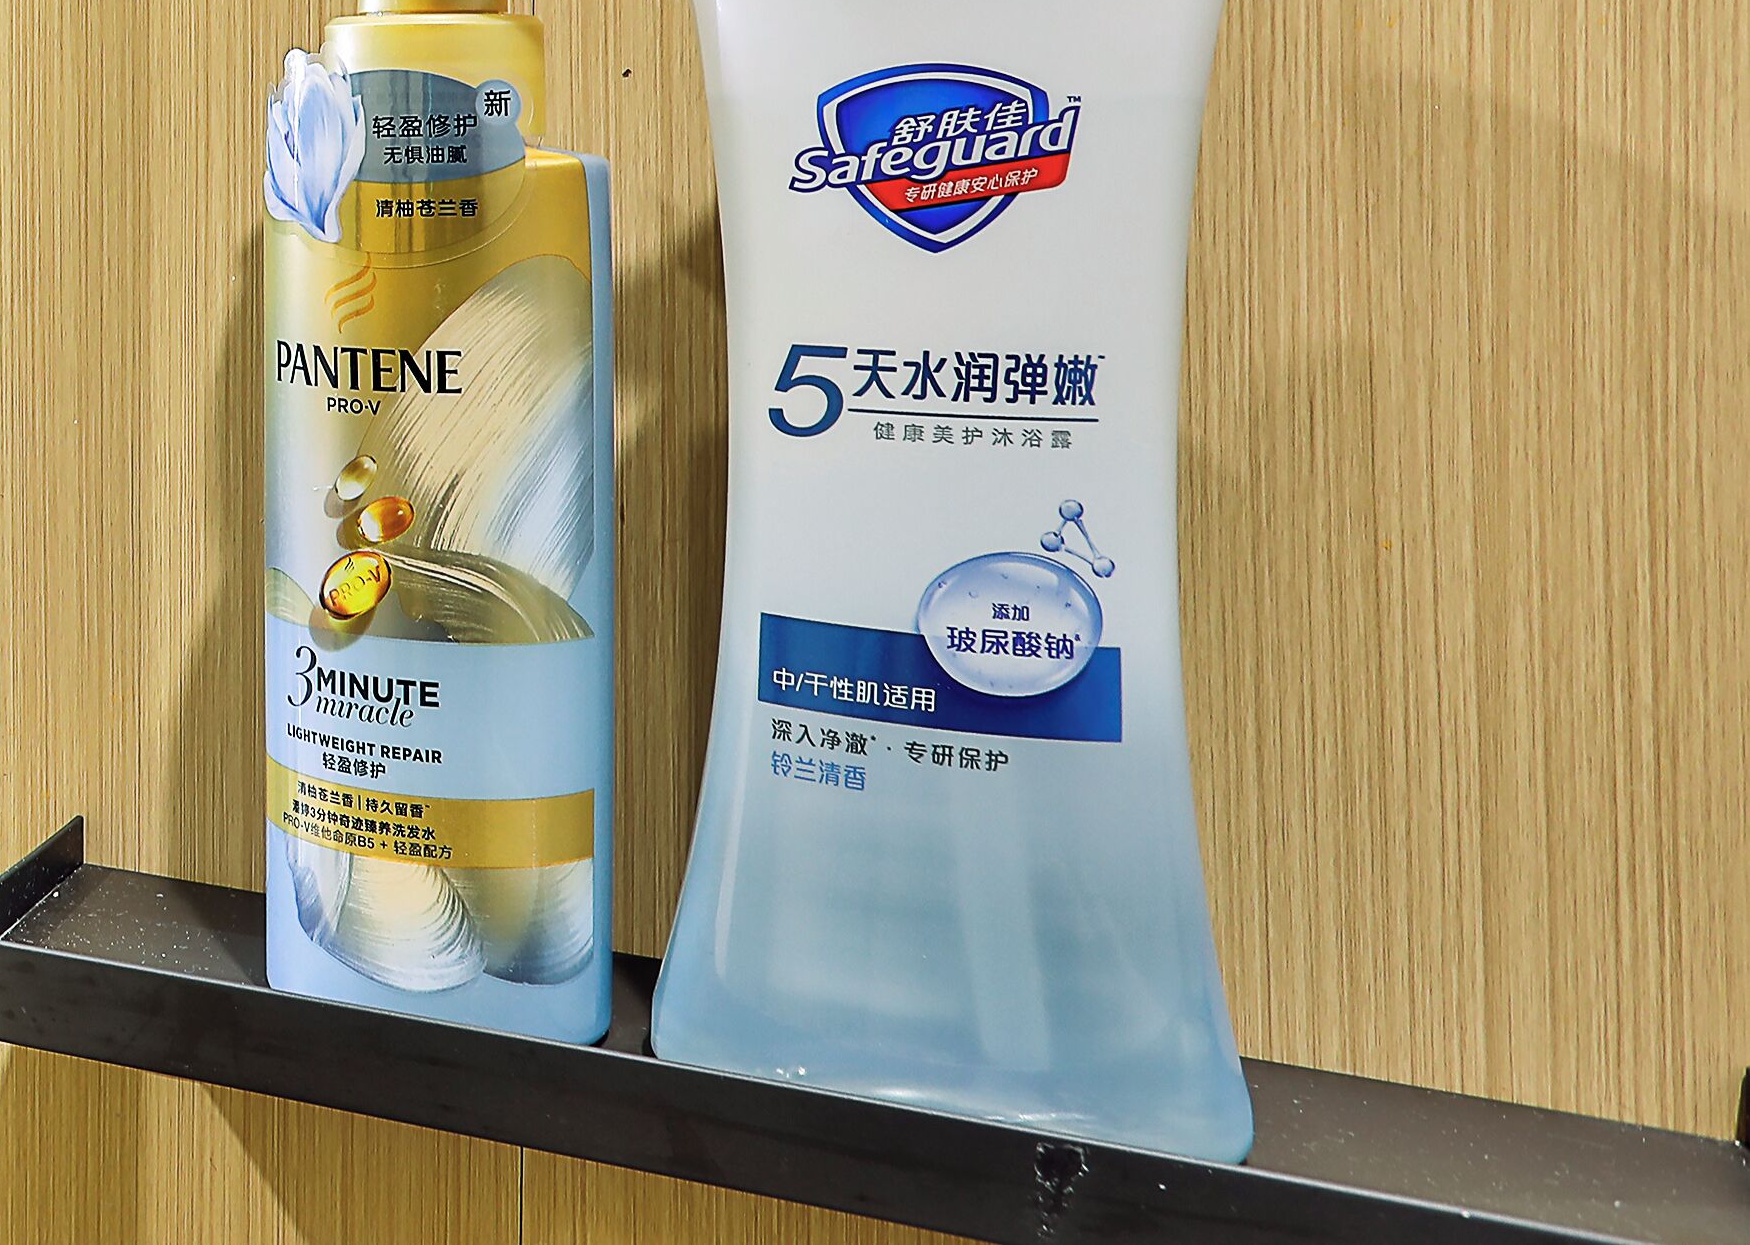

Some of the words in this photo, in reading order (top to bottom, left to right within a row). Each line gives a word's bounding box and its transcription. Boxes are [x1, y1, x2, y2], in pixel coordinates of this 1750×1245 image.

[482, 89, 512, 117] 新
[371, 114, 478, 140] 轻盈修护
[891, 99, 1027, 144] 舒肤佳
[382, 145, 468, 165] 无惧油腻
[792, 105, 1080, 191] Safeguard
[904, 168, 1038, 203] 专研健康安心保护
[375, 198, 479, 218] 清柚苍兰香
[276, 339, 463, 395] PANTENE
[326, 396, 382, 416] PRO-V
[873, 420, 1073, 450] 健康美护沐浴露
[991, 602, 1030, 622] 添加
[287, 645, 317, 708] 3
[316, 666, 441, 708] MINUTE
[772, 667, 937, 713] 中/干性肌适用
[315, 696, 416, 728] miracle
[286, 722, 376, 759] LIGHTWEIGHT
[380, 744, 443, 765] REPAIR
[904, 740, 1009, 772] 专研保护
[322, 752, 386, 780] 轻盈修护
[770, 749, 867, 791] 铃兰清香
[393, 839, 453, 860] 轻盈配方
